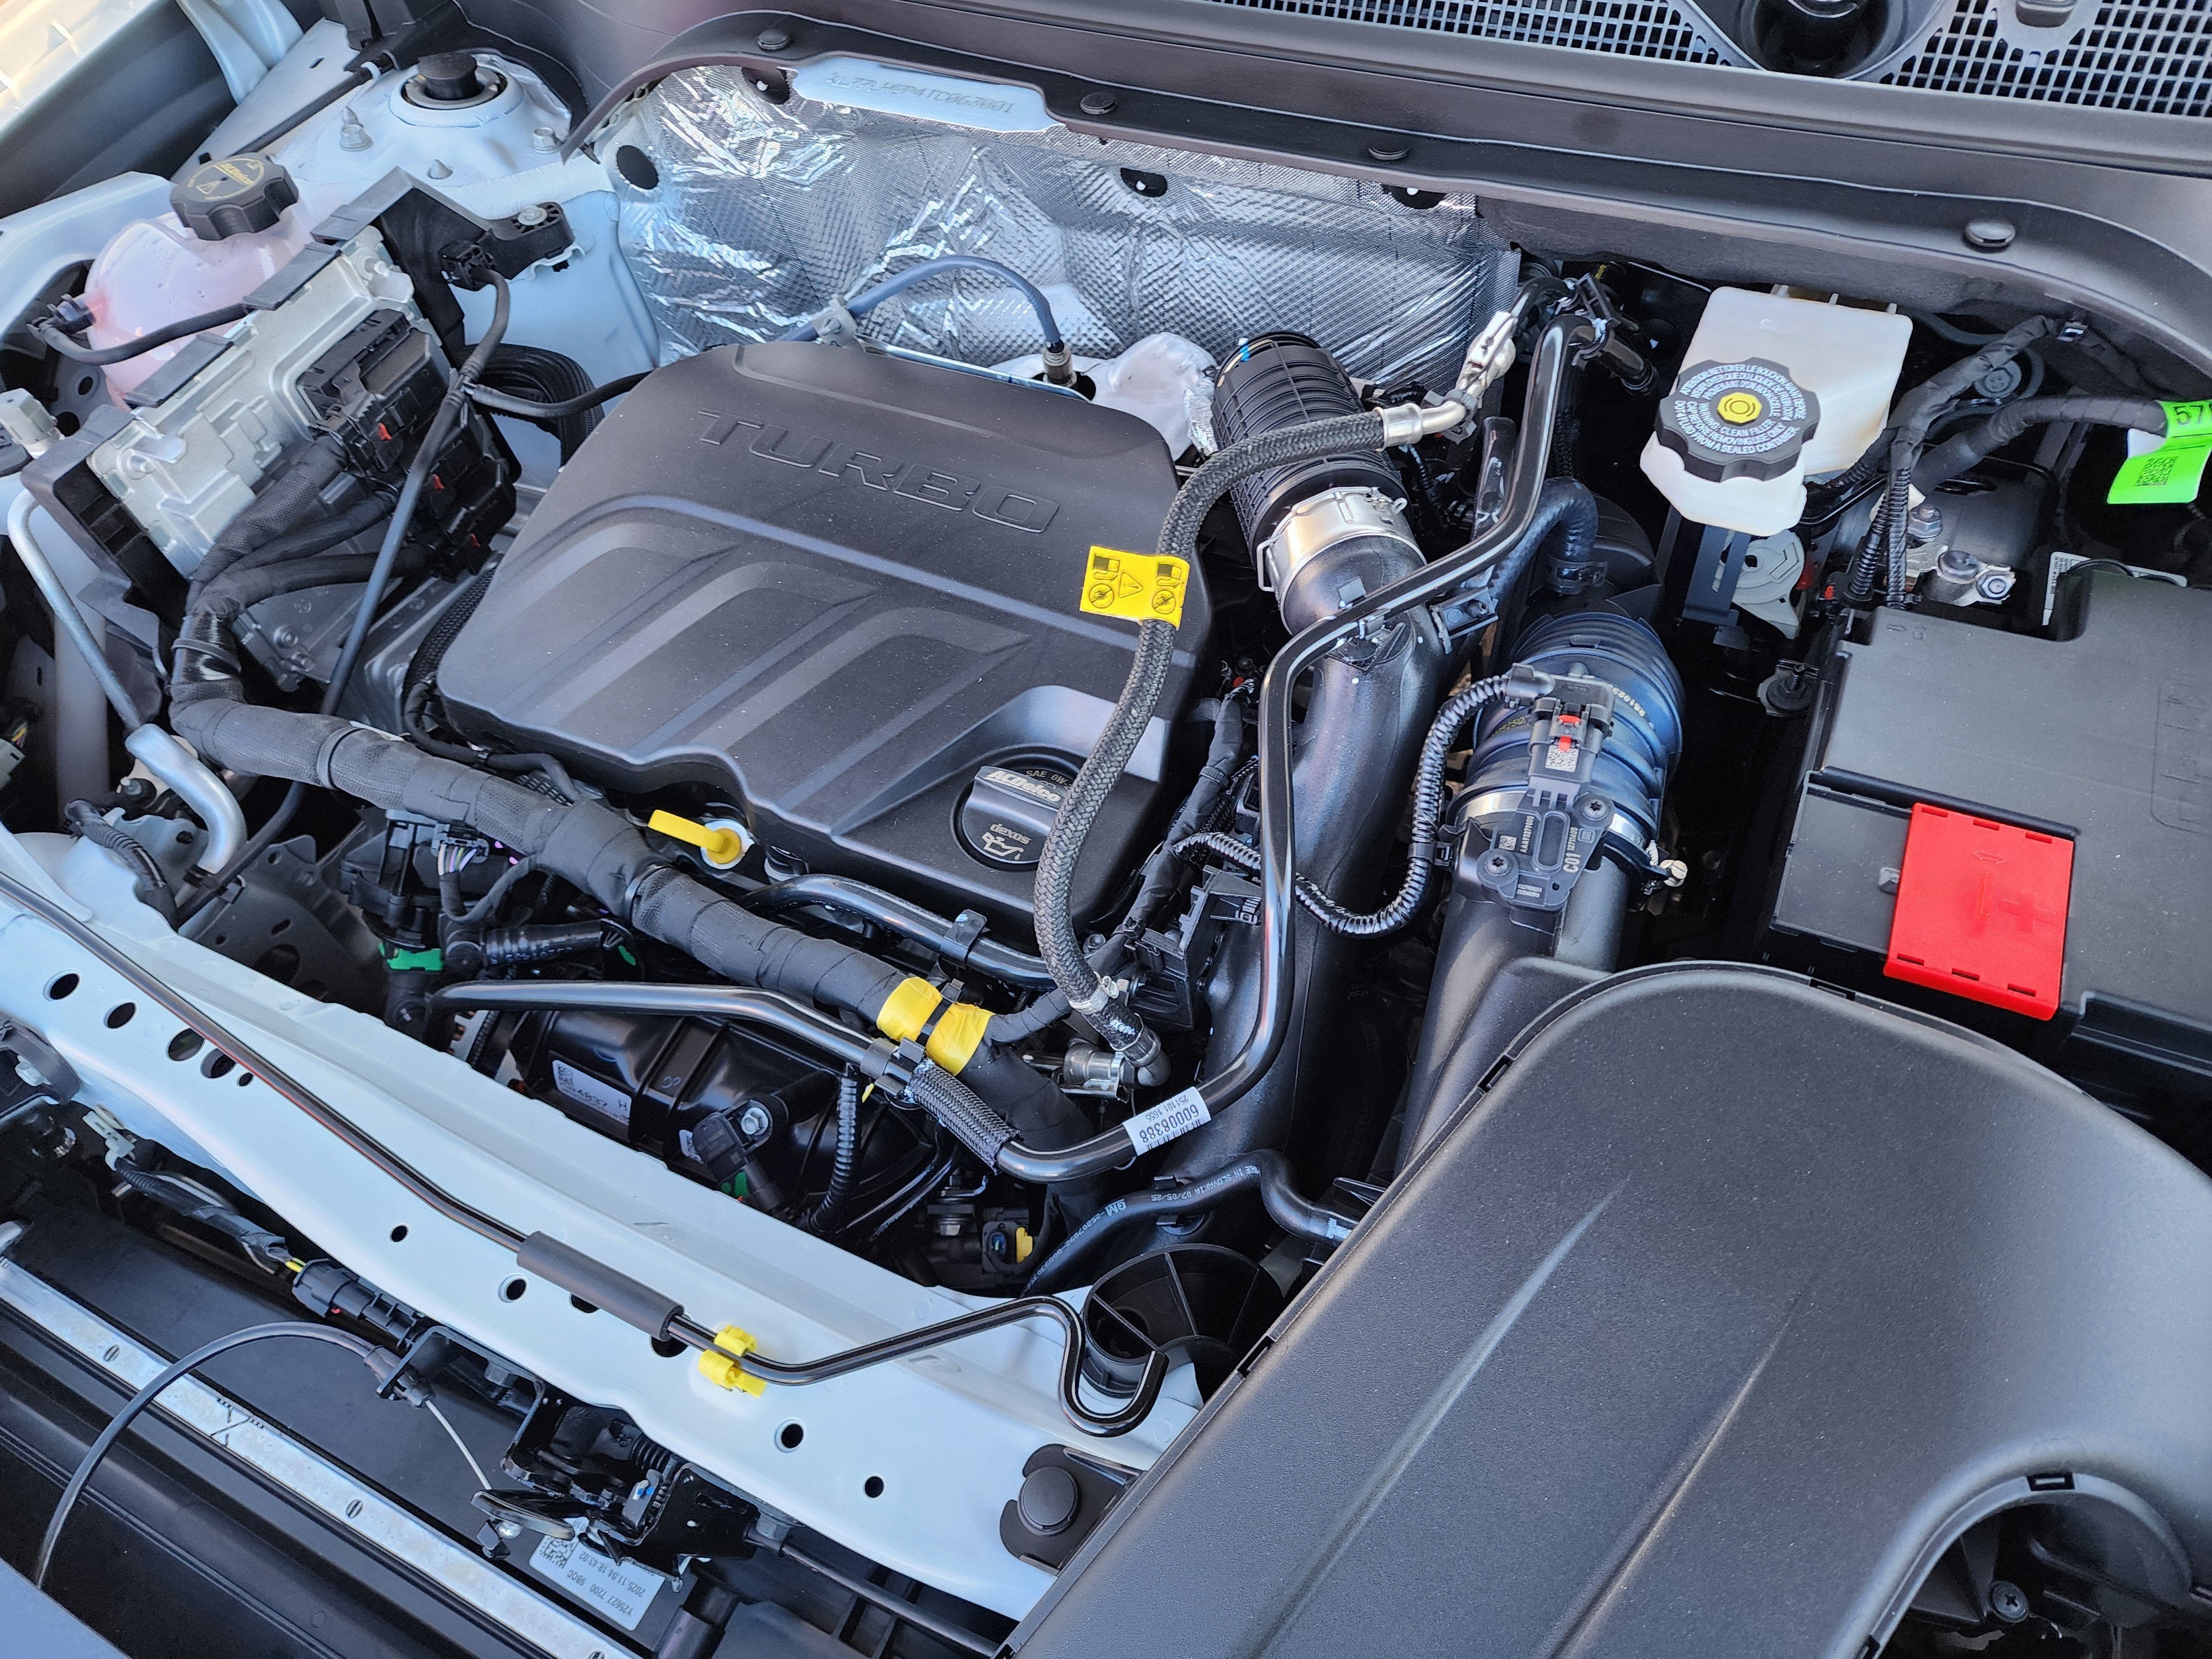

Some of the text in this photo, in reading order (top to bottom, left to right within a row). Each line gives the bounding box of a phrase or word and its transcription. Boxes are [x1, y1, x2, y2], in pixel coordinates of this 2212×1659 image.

[2173, 404, 2212, 425] 57
[698, 410, 1060, 533] TURBO
[984, 770, 1061, 802] ACDelco
[1026, 770, 1072, 790] SAE 0W-2
[990, 823, 1032, 844] dexos
[1563, 852, 1582, 873] C01
[1145, 1094, 1189, 1122] 251101 1655
[1140, 1104, 1199, 1143] 60008388
[1194, 1175, 1232, 1194] SLOVAKIA
[1234, 1170, 1243, 1178] IN
[1151, 1188, 1192, 1202] 07/05/25
[579, 1551, 608, 1573] 18:43:02
[589, 1584, 607, 1600] 7200
